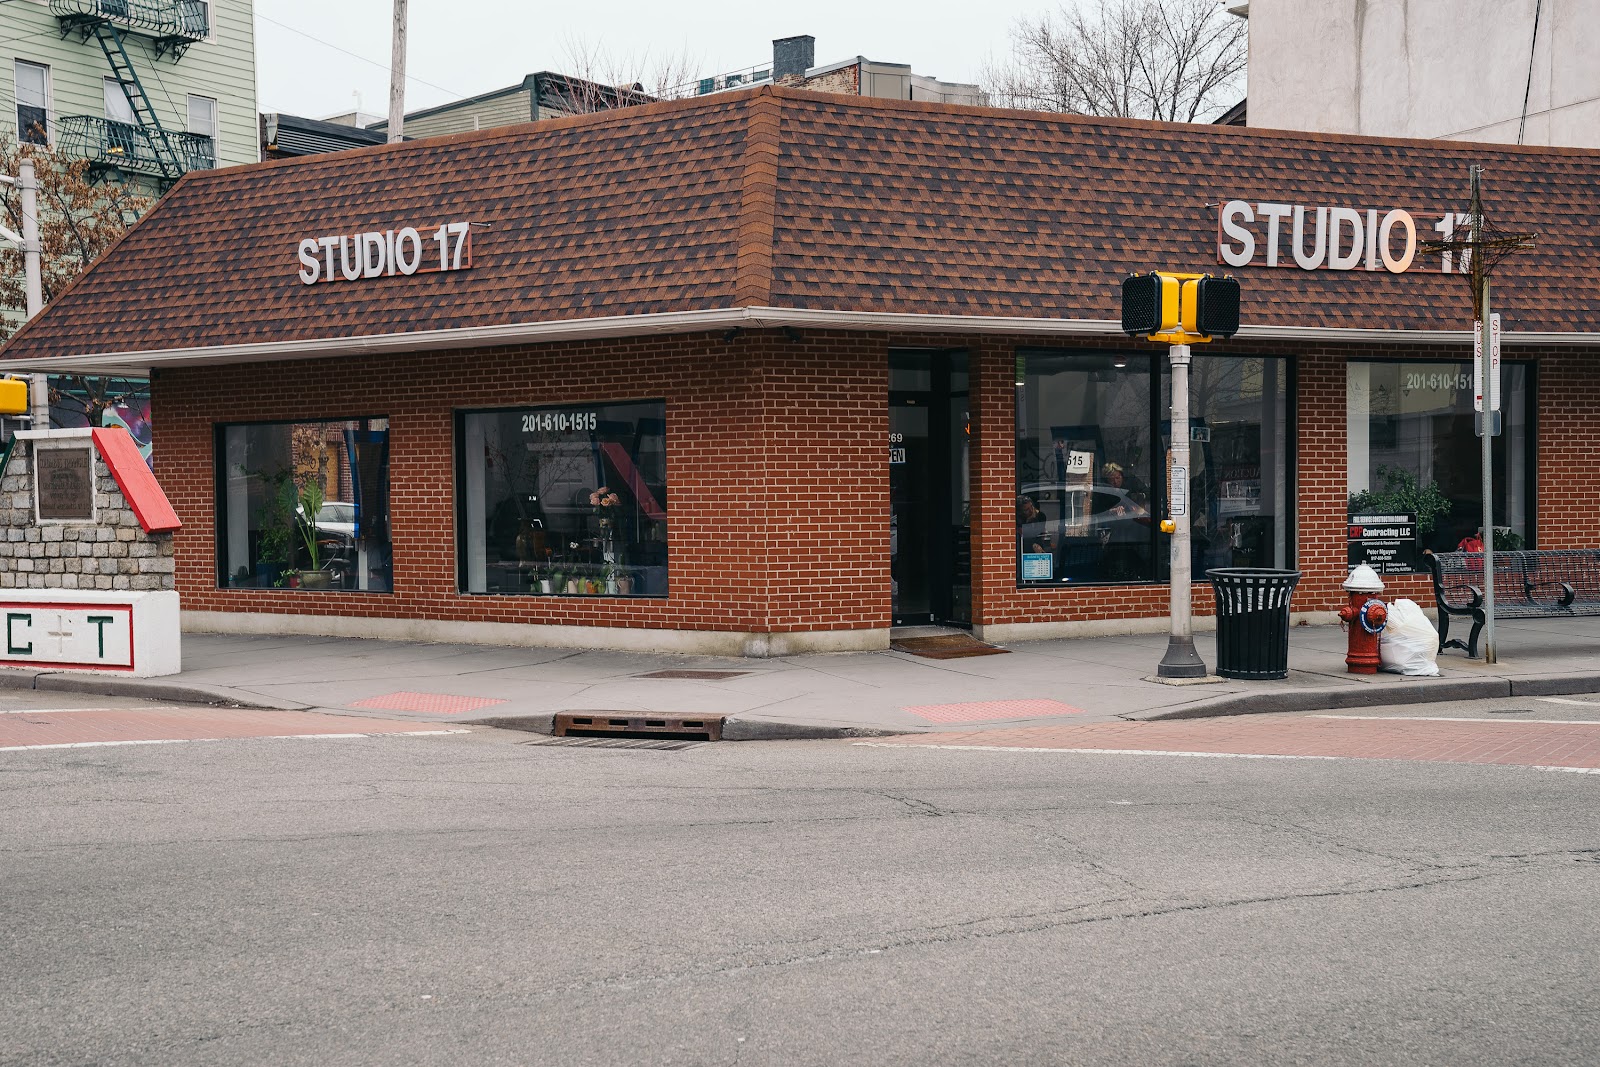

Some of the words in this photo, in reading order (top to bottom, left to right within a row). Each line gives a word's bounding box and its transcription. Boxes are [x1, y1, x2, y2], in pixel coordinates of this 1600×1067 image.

[1220, 200, 1416, 273] STUDIO
[1435, 213, 1484, 273] 17
[299, 227, 422, 285] STUDIO
[434, 222, 469, 271] 17
[1406, 373, 1475, 389] 201-610-151
[522, 412, 597, 432] 201-610-1515
[889, 432, 903, 443] 69
[889, 449, 903, 462] EN
[1363, 528, 1398, 537] Contracting
[1400, 528, 1410, 536] LLC
[7, 613, 33, 655] C
[87, 616, 114, 658] T
